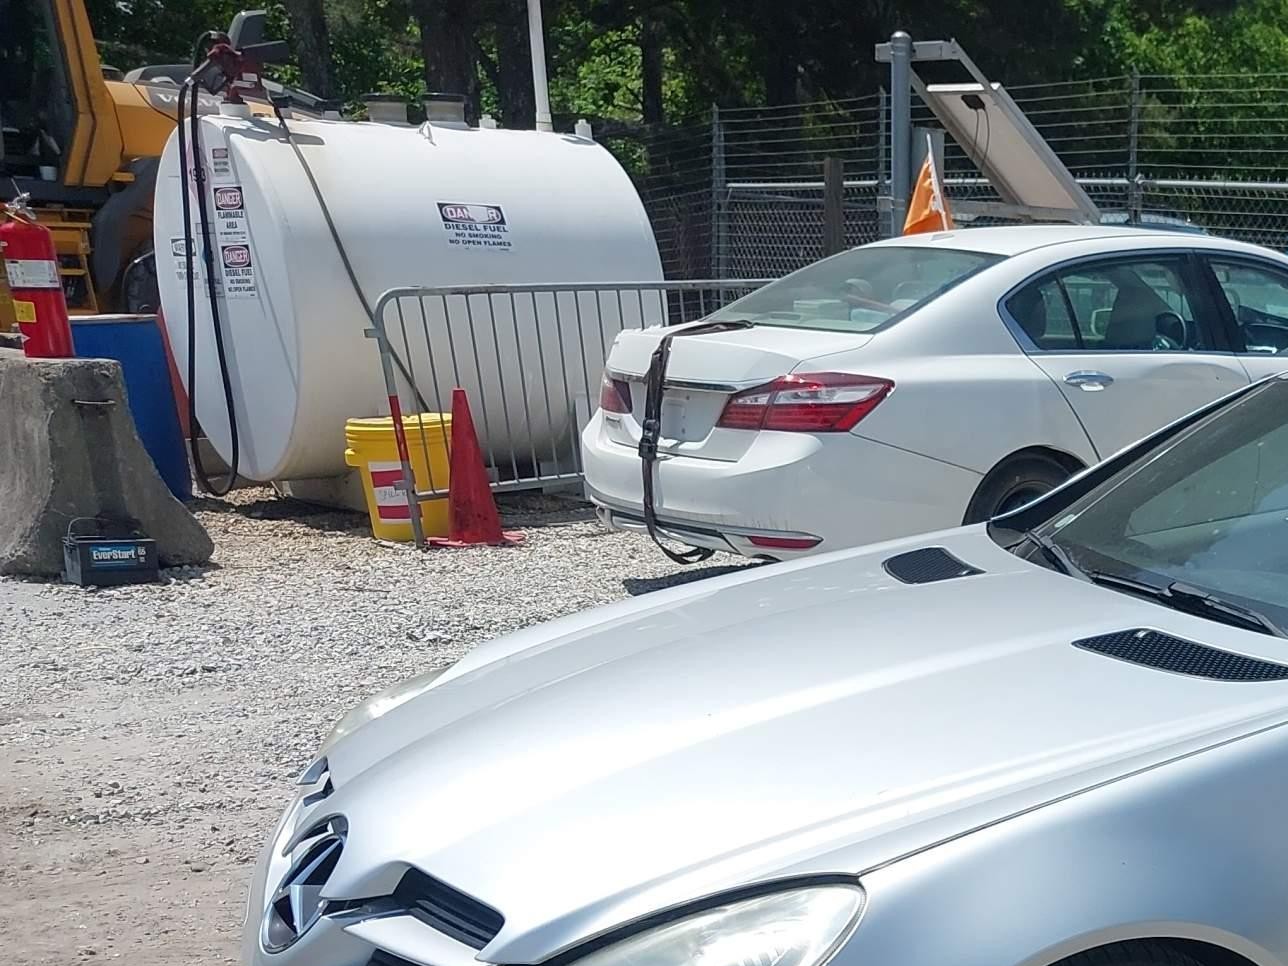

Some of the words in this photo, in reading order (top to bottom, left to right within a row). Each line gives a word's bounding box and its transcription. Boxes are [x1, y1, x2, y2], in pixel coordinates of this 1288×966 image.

[446, 207, 498, 221] DANR
[444, 223, 480, 231] DIESEL
[92, 549, 136, 560] EverStart
